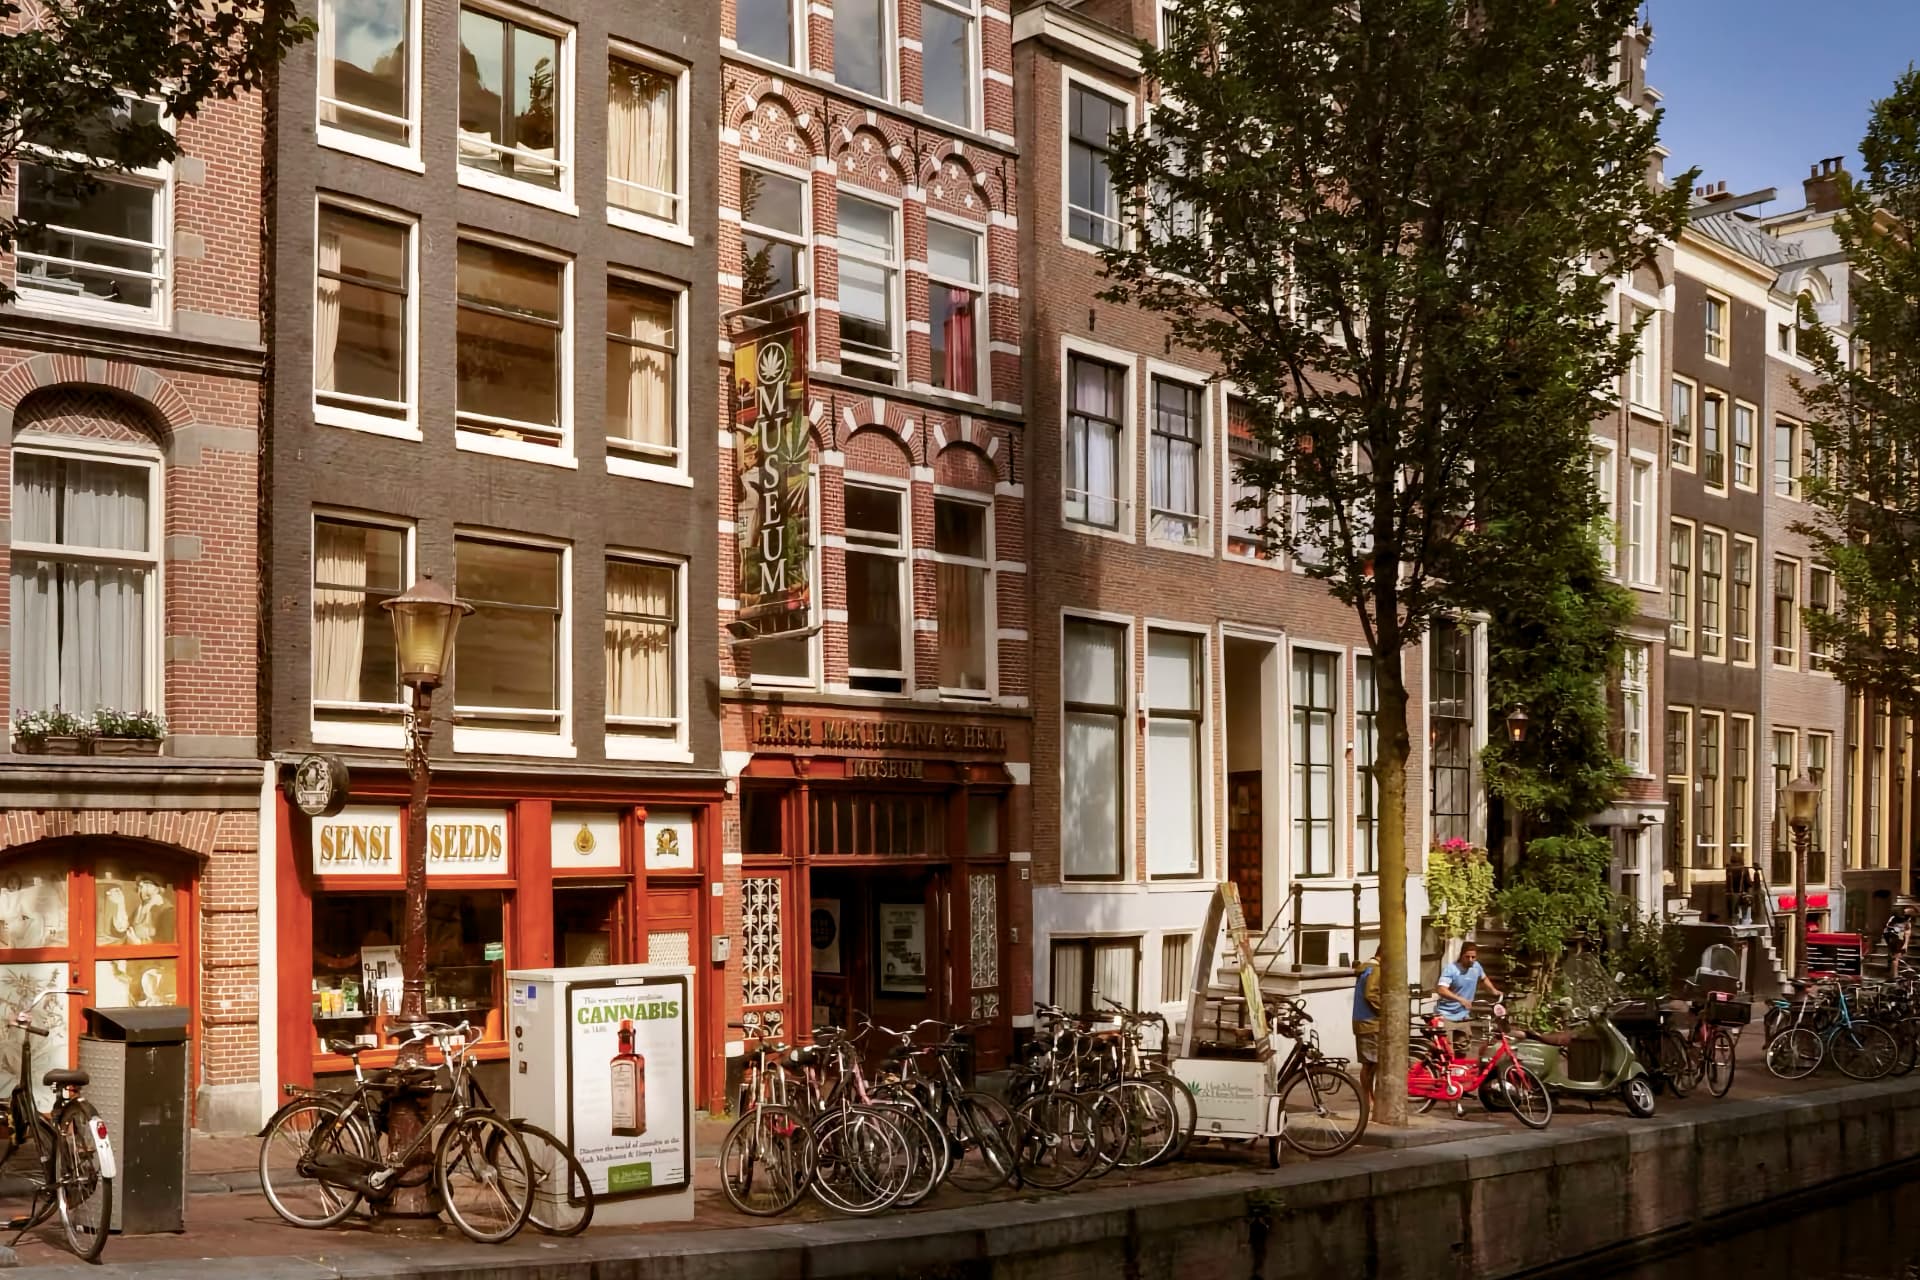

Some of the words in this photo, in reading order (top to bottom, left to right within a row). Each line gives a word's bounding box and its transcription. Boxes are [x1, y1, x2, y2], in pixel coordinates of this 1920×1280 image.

[757, 379, 788, 596] MUSEUM
[760, 716, 812, 740] HASH
[822, 718, 937, 745] MARIHUANA
[944, 727, 958, 746] &
[853, 759, 924, 779] MUSEUM
[320, 825, 393, 861] SENSI
[430, 824, 502, 859] SEEDS
[577, 1000, 680, 1025] CANNABIS
